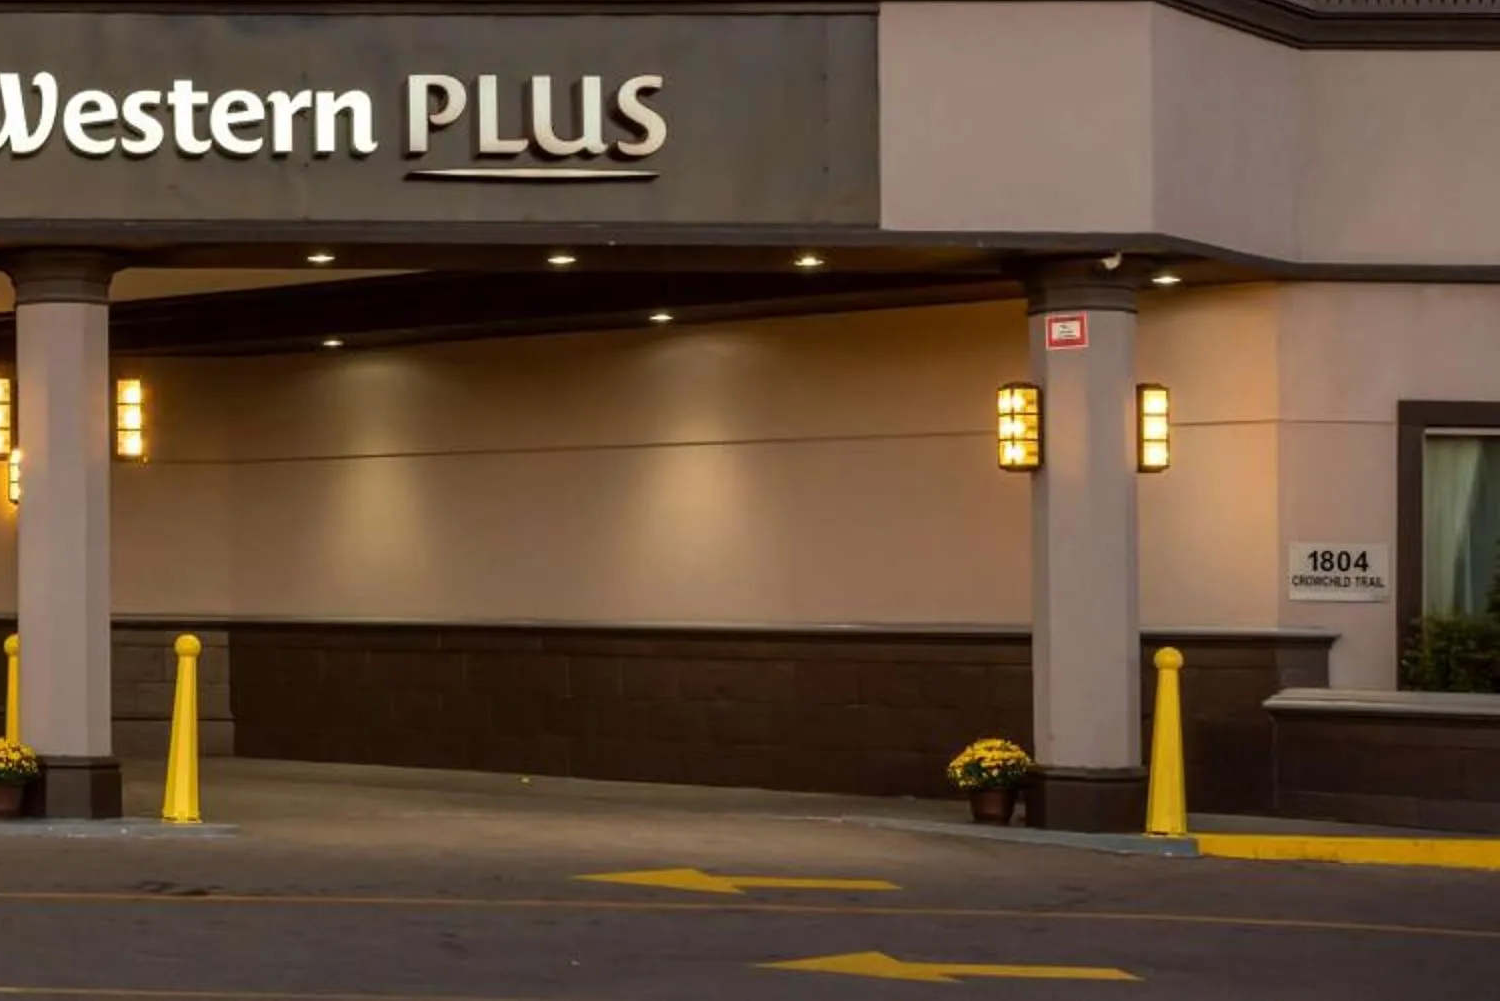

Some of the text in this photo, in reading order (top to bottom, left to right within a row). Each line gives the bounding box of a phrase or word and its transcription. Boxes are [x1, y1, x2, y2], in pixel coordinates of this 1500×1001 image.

[404, 74, 668, 157] PLUS
[1308, 550, 1368, 572] 1804
[1291, 576, 1385, 588] CROWCHILD TRAIL
